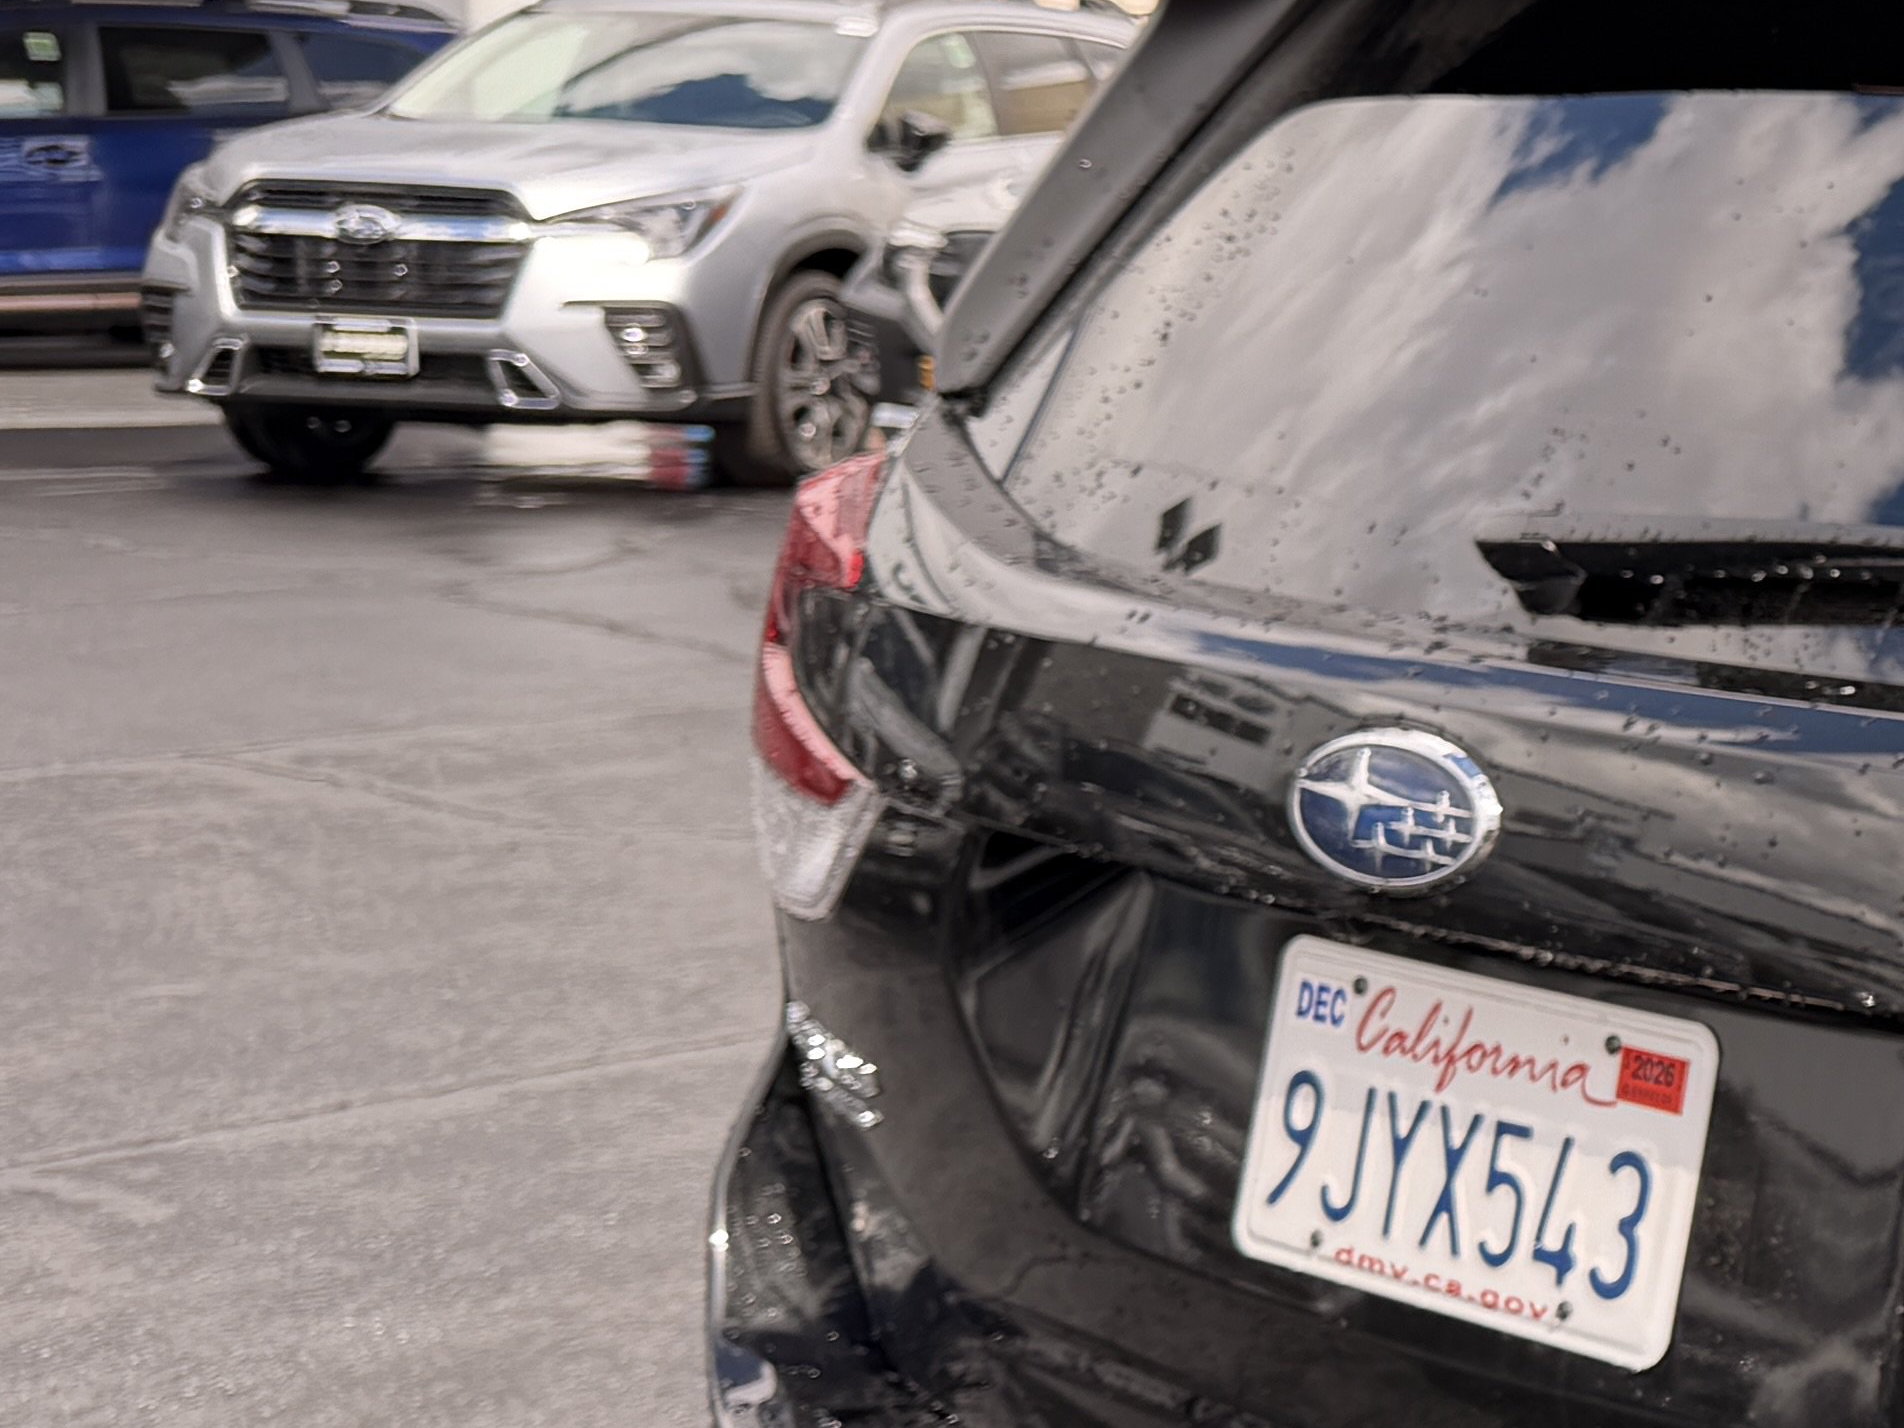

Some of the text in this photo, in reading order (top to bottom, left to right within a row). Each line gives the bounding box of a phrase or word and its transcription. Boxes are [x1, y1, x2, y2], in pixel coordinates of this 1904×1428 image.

[1296, 980, 1348, 1028] DEC
[1354, 986, 1618, 1108] California
[1631, 1054, 1677, 1088] 2026
[1266, 1070, 1653, 1301] 9JYX543
[1334, 1245, 1548, 1322] dmv.ca.gov
